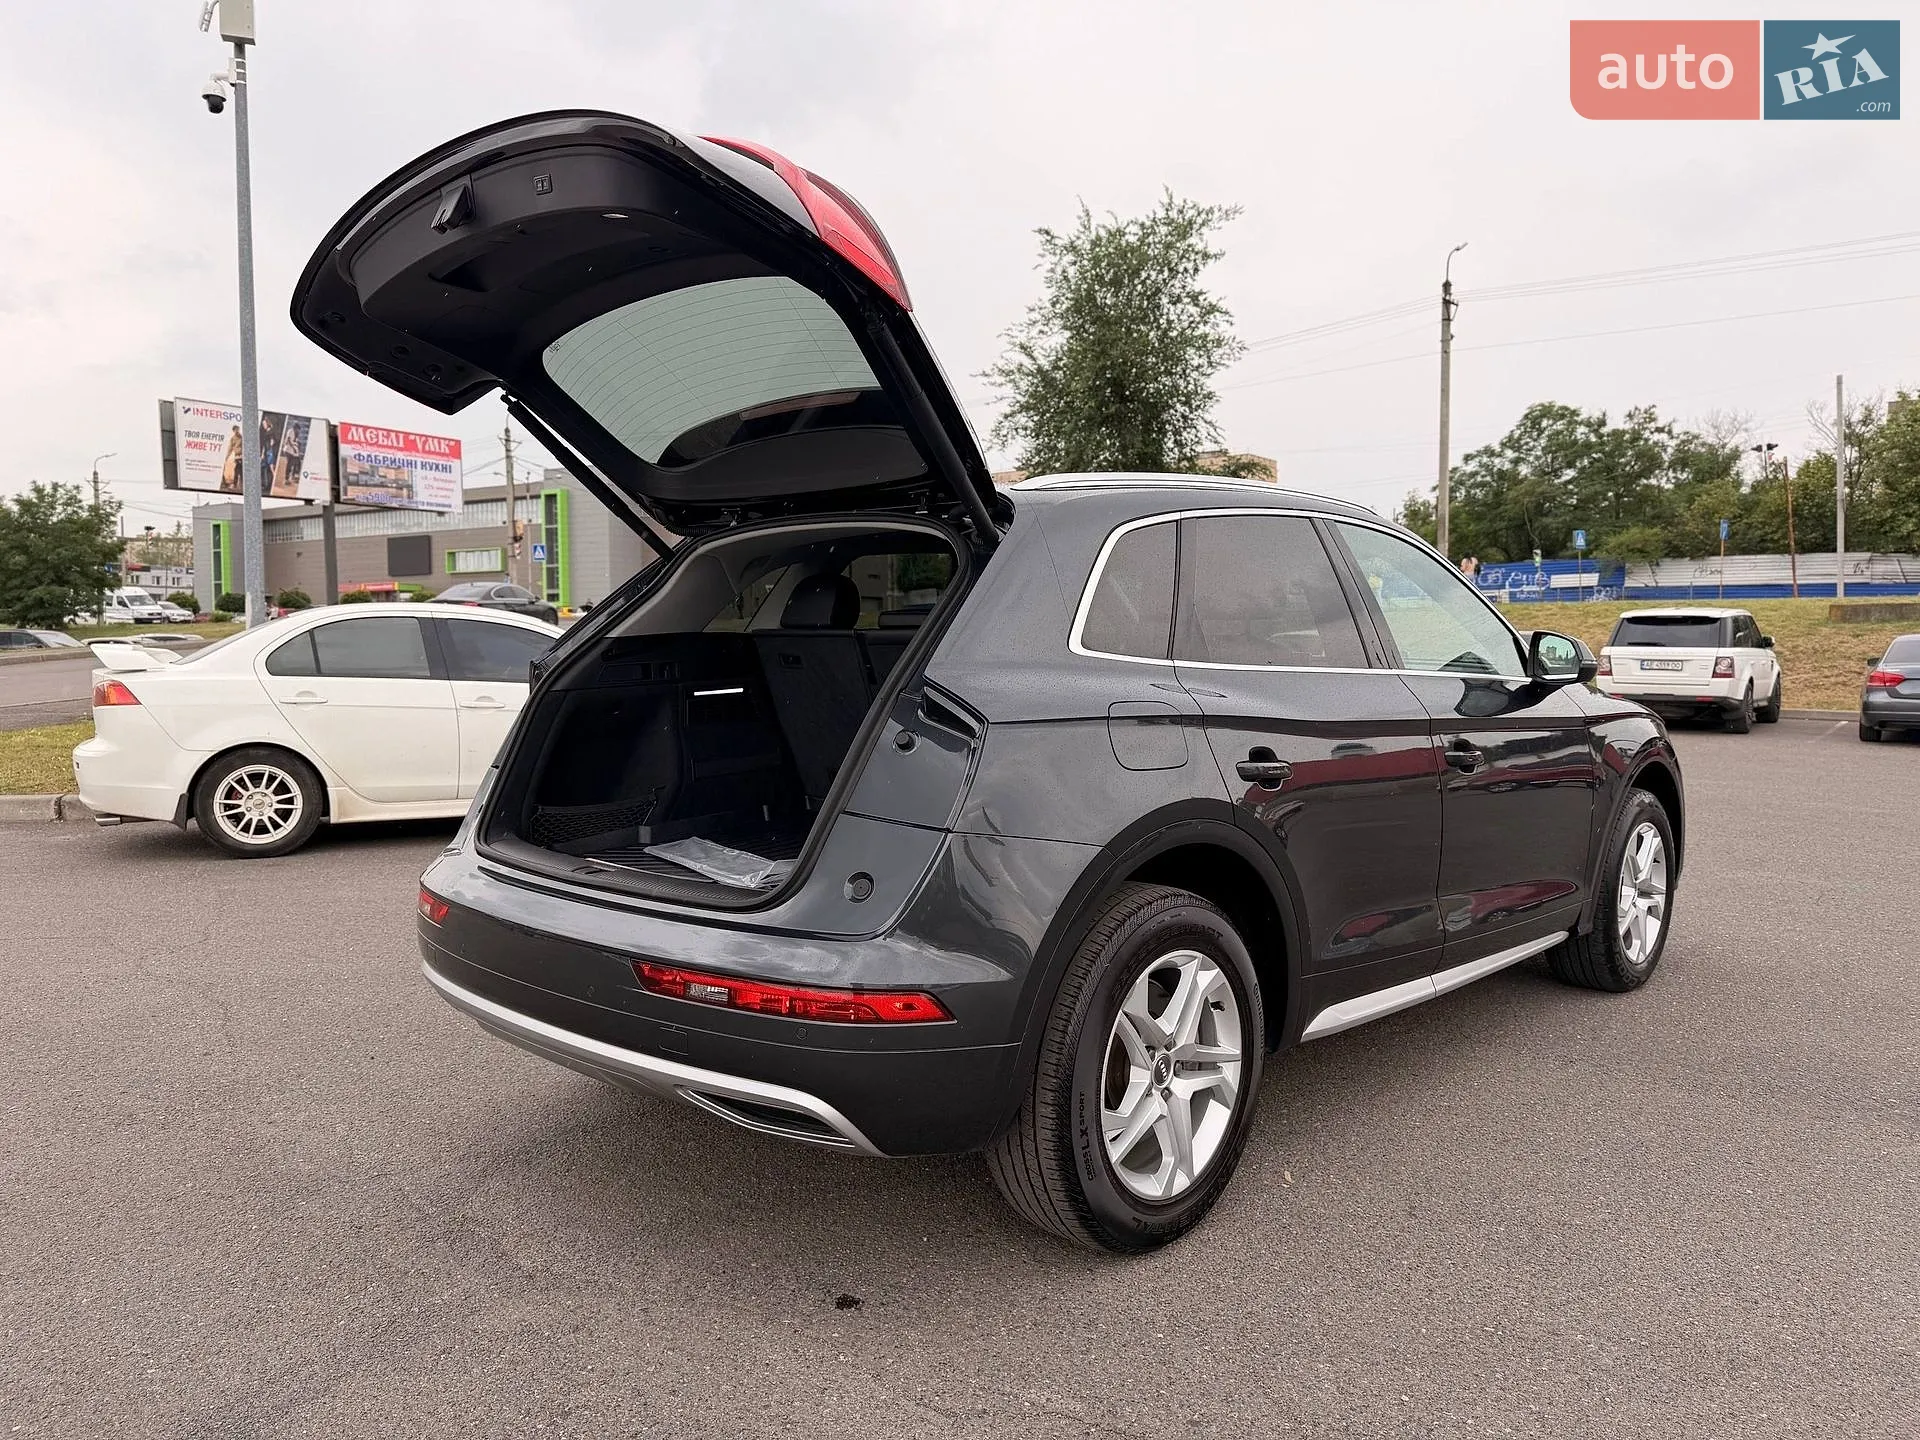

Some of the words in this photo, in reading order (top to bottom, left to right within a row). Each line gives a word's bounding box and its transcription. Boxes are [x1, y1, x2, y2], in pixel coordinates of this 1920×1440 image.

[192, 407, 242, 423] INTERSPO
[184, 430, 200, 439] ТВОЯ
[184, 440, 208, 451] ЖИВЕ
[209, 442, 223, 453] ТУТ
[353, 452, 418, 470] ФАБРИЧНІ
[420, 461, 453, 474] КУХНІ
[1080, 1125, 1090, 1151] LX
